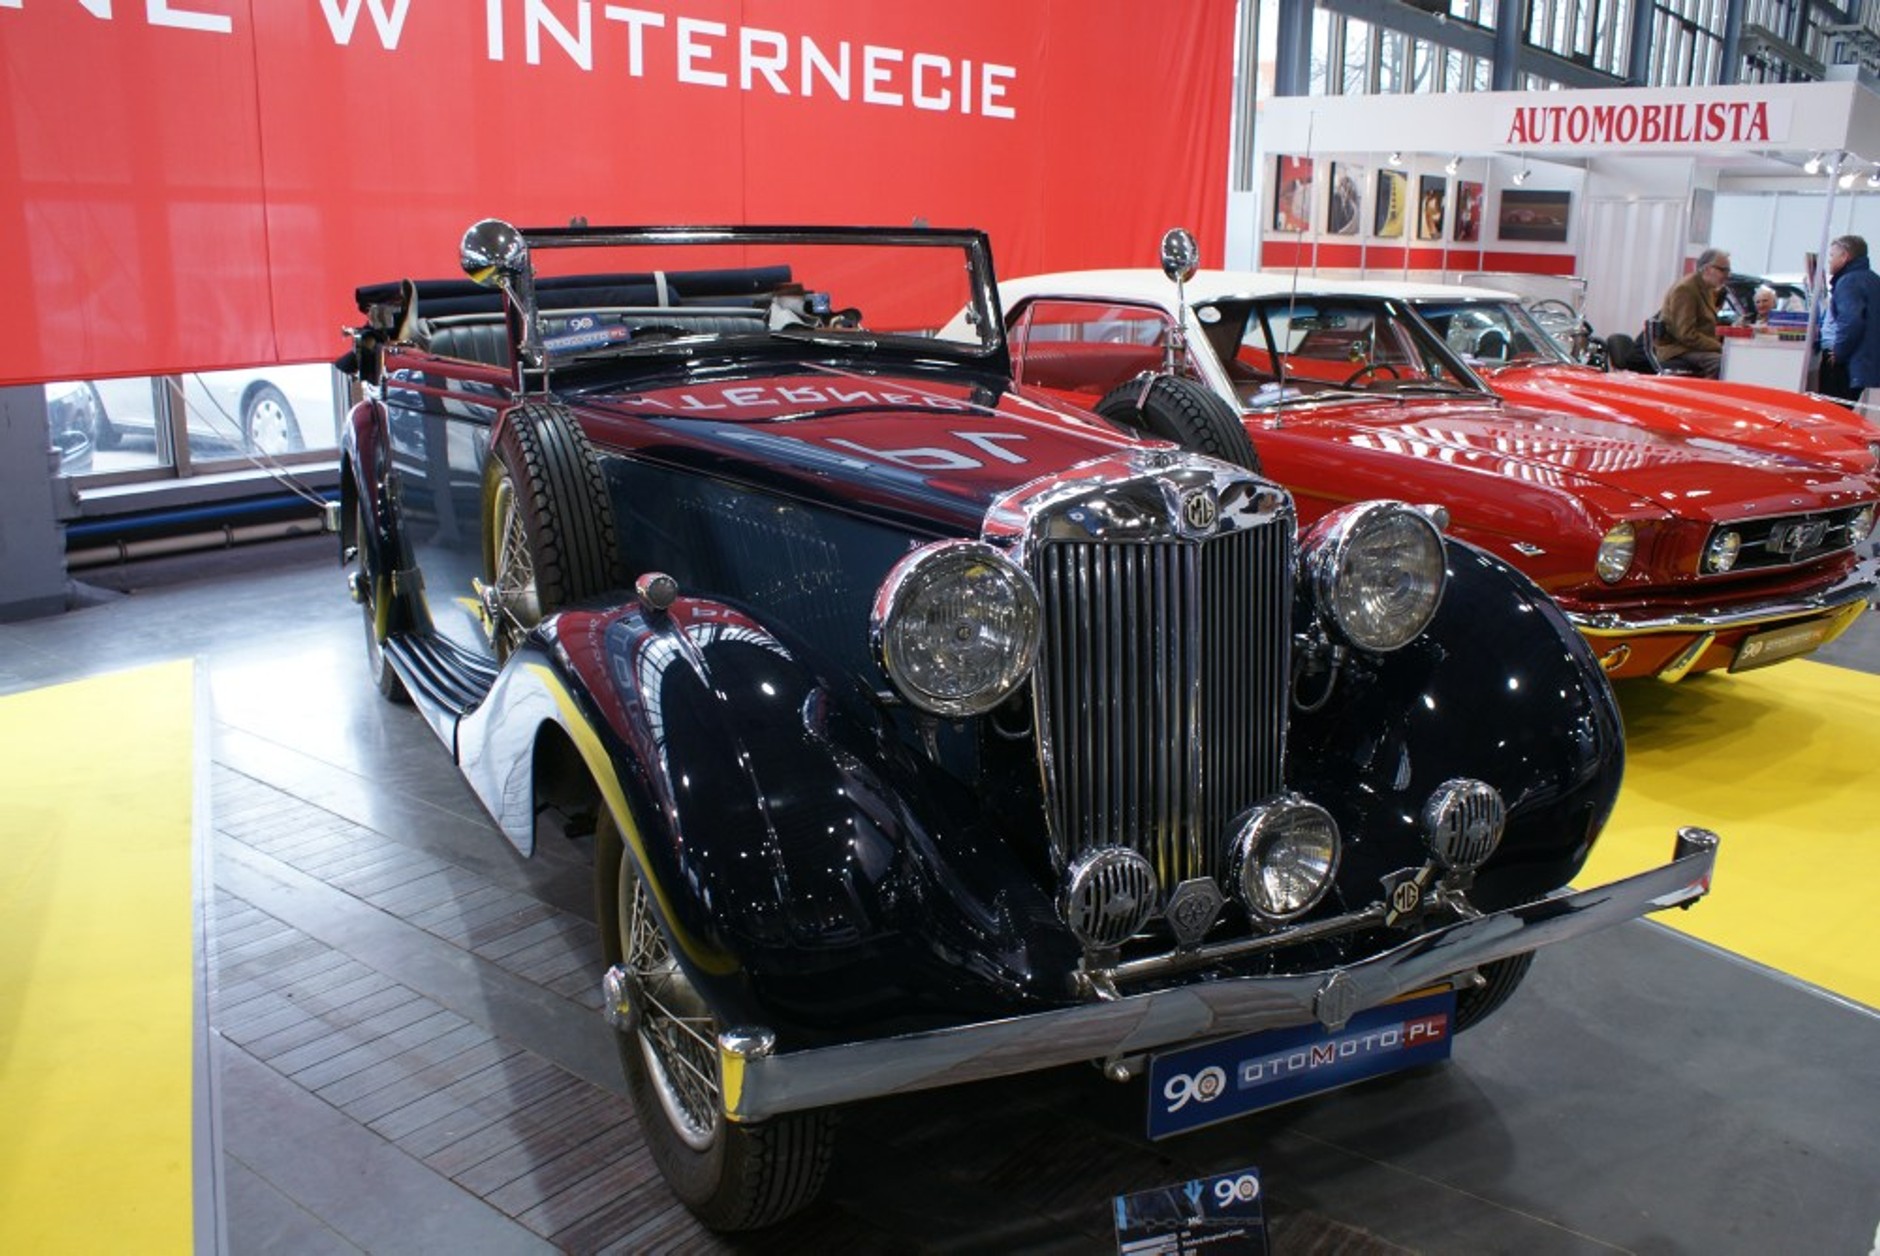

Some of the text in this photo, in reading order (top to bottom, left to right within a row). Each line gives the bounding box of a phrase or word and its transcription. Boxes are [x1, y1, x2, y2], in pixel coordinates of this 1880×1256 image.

[319, 0, 1017, 119] W INTERNECIE
[1507, 102, 1770, 143] AUTOMOBILISTA
[1187, 494, 1216, 528] MG
[1393, 882, 1419, 913] MG
[1163, 1019, 1441, 1113] 90 OTOMOTO.PL
[1214, 1174, 1260, 1208] 90
